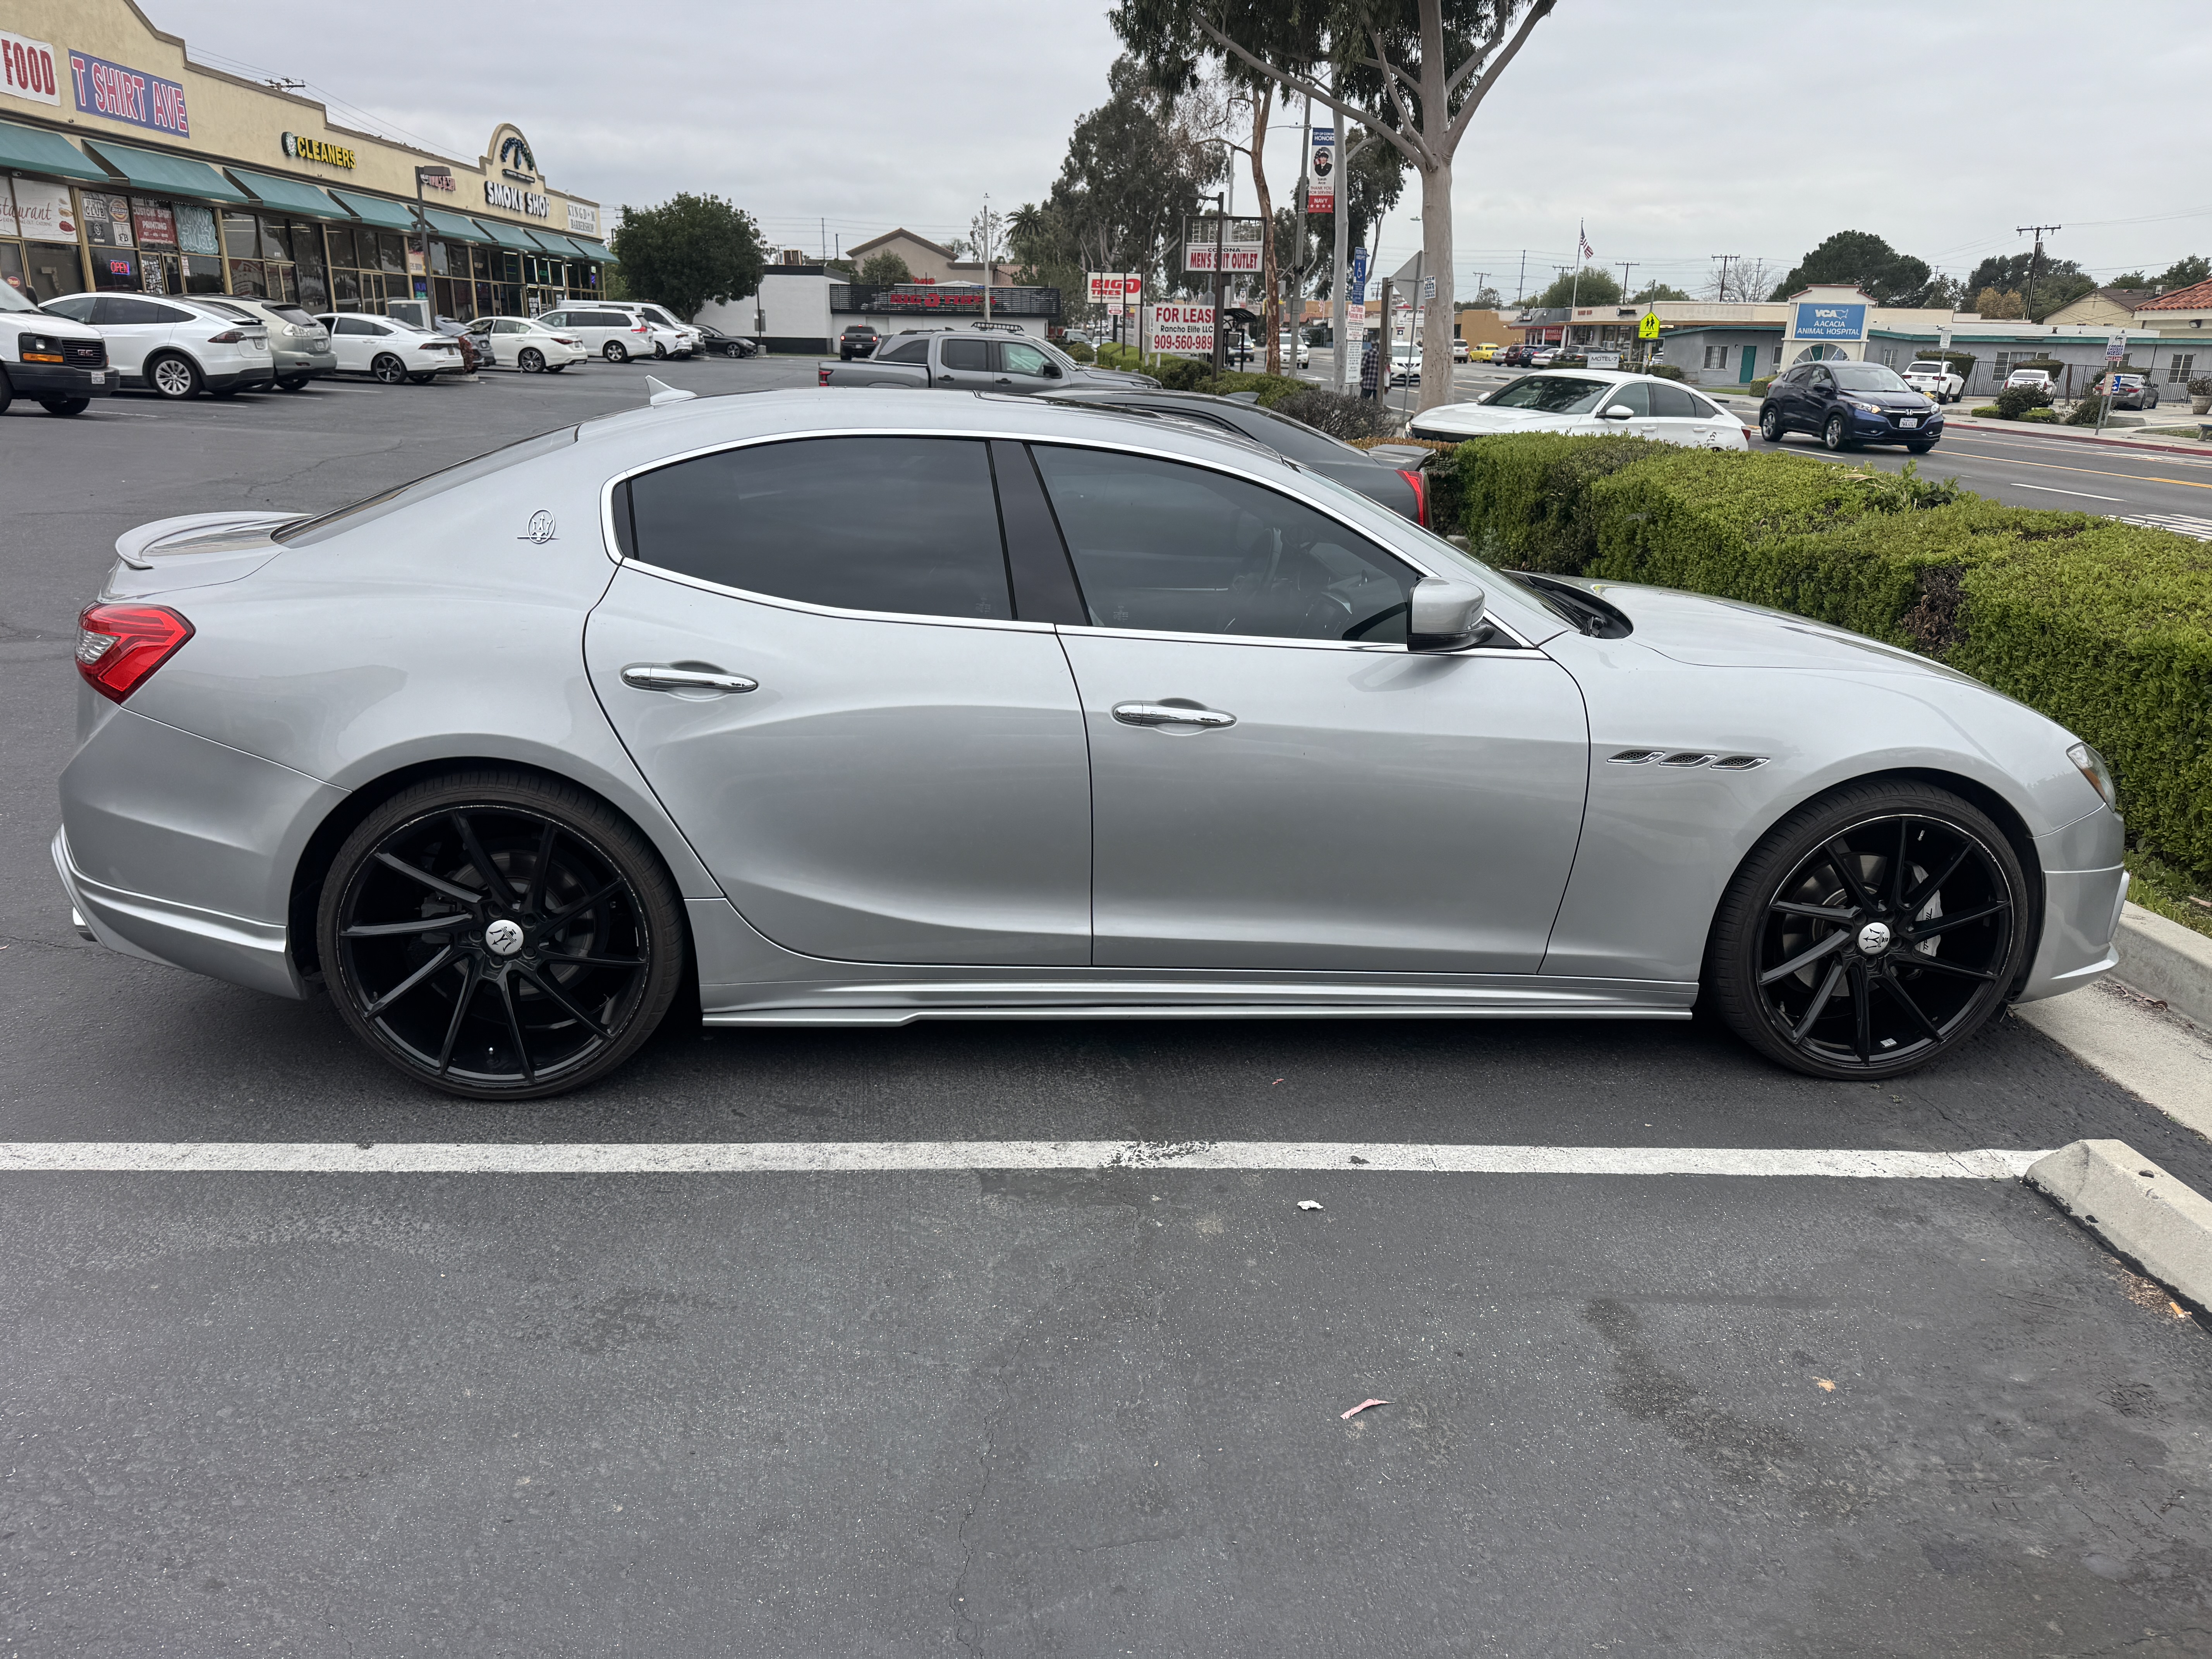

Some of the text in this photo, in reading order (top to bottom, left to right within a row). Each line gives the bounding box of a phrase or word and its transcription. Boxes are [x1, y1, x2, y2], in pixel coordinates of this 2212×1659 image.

[1, 40, 55, 96] FOOD
[71, 56, 187, 132] T SHIRT AVE
[297, 136, 357, 169] CLEANERS
[486, 180, 524, 211] SMOKE
[526, 192, 551, 217] SHOP
[86, 206, 105, 217] CLUB
[133, 206, 156, 217] CUSTOM
[142, 220, 167, 231] PRINTING
[110, 261, 129, 273] OPEN
[1190, 252, 1258, 269] MEN'S SIT OUTLET
[1091, 279, 1123, 289] BIG
[890, 294, 922, 304] BIG
[1156, 307, 1179, 323] FOR
[1815, 309, 1837, 318] VCA
[1154, 335, 1212, 350] 909-560-989
